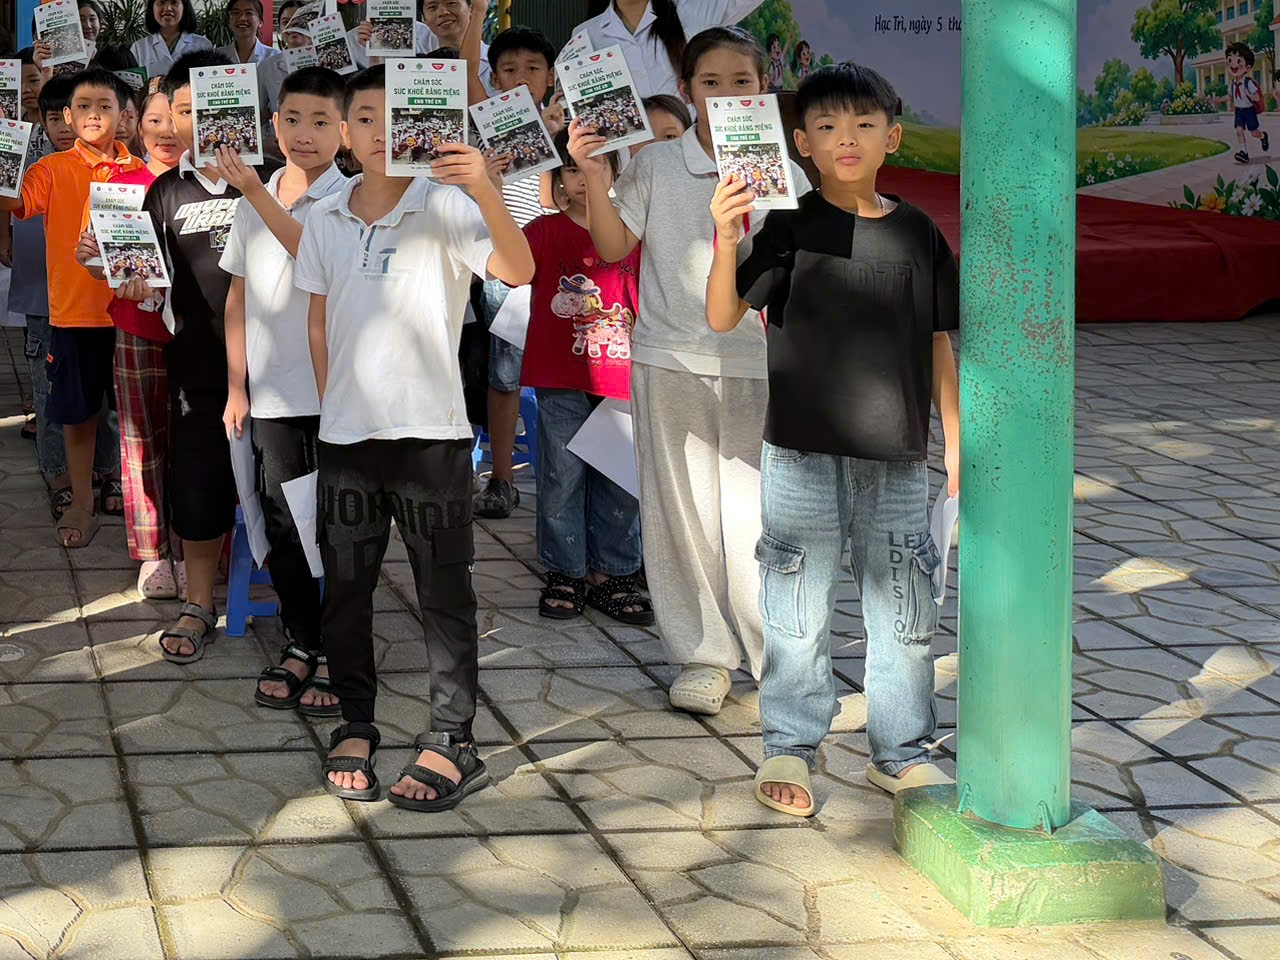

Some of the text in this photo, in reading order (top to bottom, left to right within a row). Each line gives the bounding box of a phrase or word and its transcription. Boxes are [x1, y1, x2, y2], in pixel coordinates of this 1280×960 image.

[875, 16, 891, 34] Hạc
[909, 18, 932, 34] ngày
[937, 17, 942, 32] 5
[443, 88, 460, 97] MIỆNG
